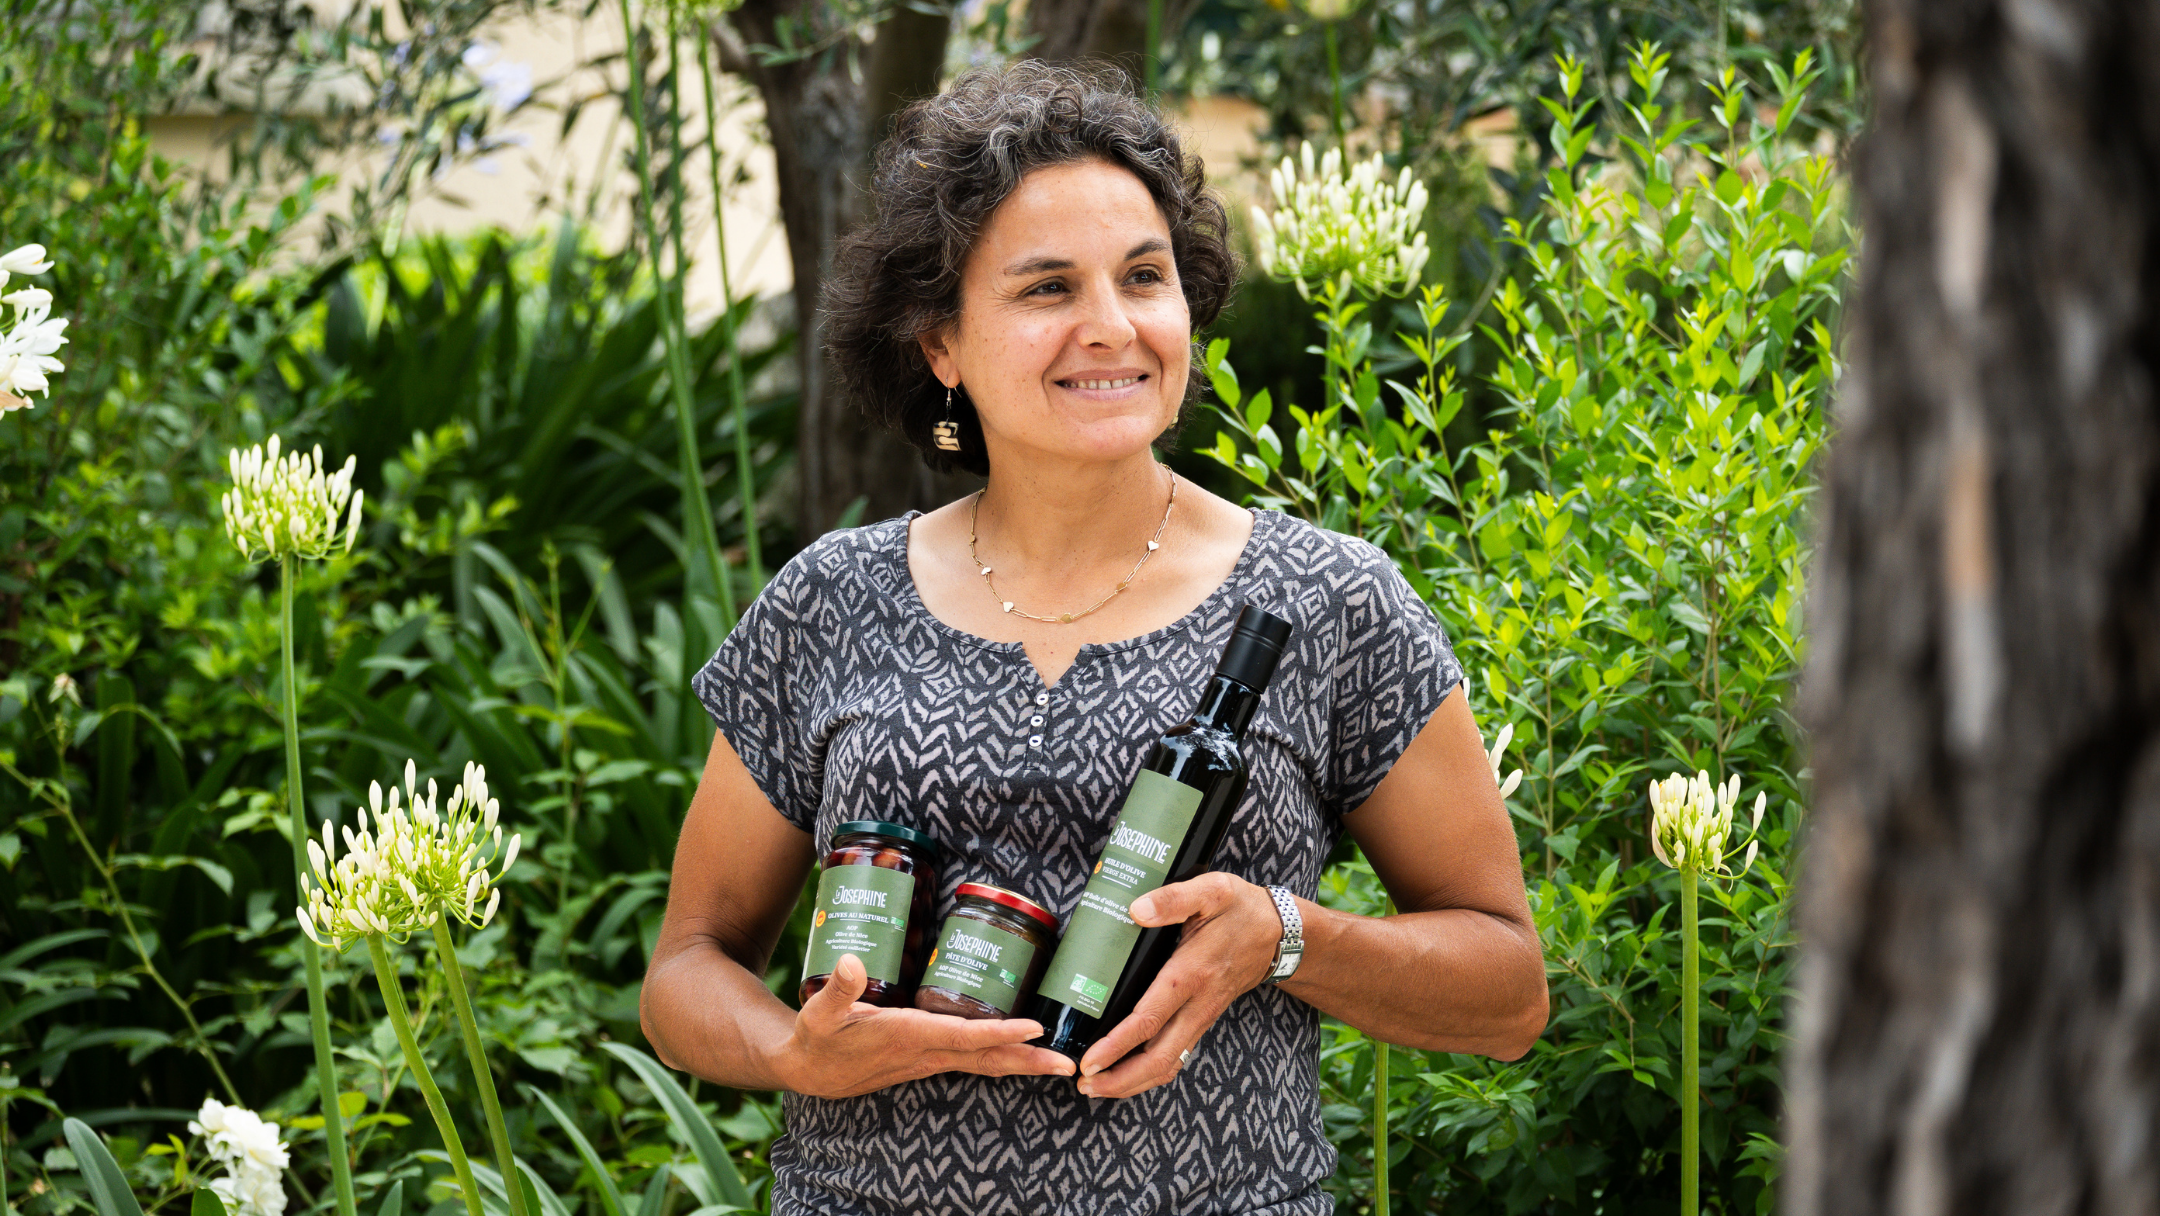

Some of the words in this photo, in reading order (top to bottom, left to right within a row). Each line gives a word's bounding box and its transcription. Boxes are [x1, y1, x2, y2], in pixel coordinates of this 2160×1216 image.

[1110, 821, 1171, 864] JOSEPHINE
[1120, 862, 1146, 878] D'OLIVE
[1119, 872, 1138, 885] EXTRA
[832, 886, 888, 908] JOSEPHINE
[858, 913, 889, 923] NATUREL
[1103, 906, 1135, 925] Biologique
[946, 929, 1002, 963] JOSEPHINE
[960, 956, 988, 971] D'OLIVE
[970, 973, 983, 982] Nice
